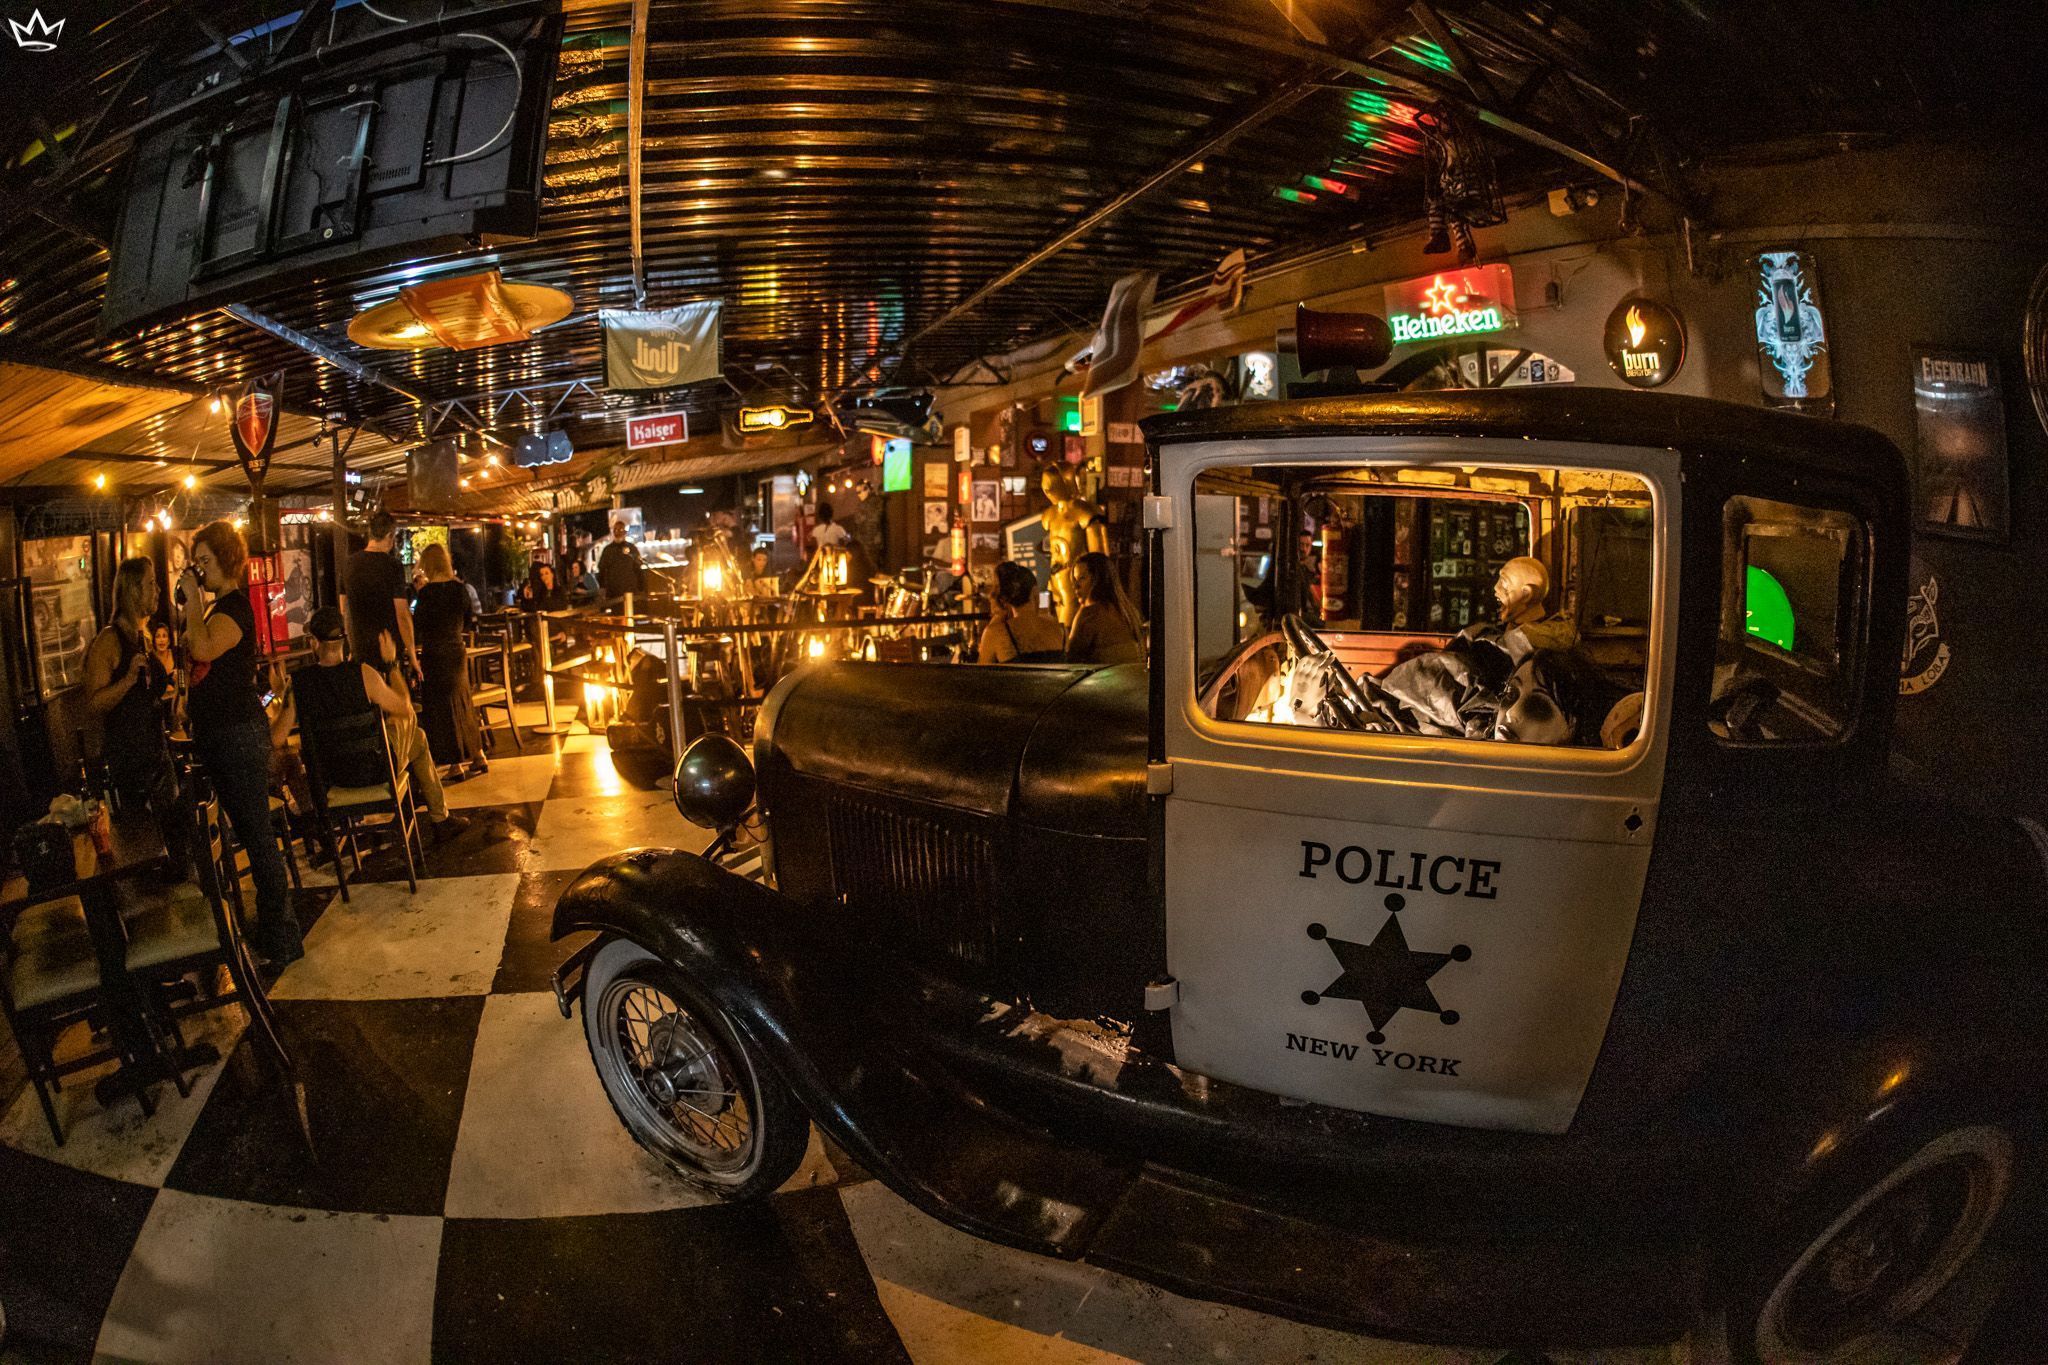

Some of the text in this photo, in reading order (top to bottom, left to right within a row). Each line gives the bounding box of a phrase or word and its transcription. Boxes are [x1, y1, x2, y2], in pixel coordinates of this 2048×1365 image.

[1391, 309, 1501, 341] Heineken
[1622, 349, 1660, 370] burn
[1921, 357, 1988, 387] EISENBAHN
[633, 423, 677, 441] Kaiser
[1299, 840, 1501, 899] POLICE
[1286, 1033, 1462, 1076] NEW YORK
